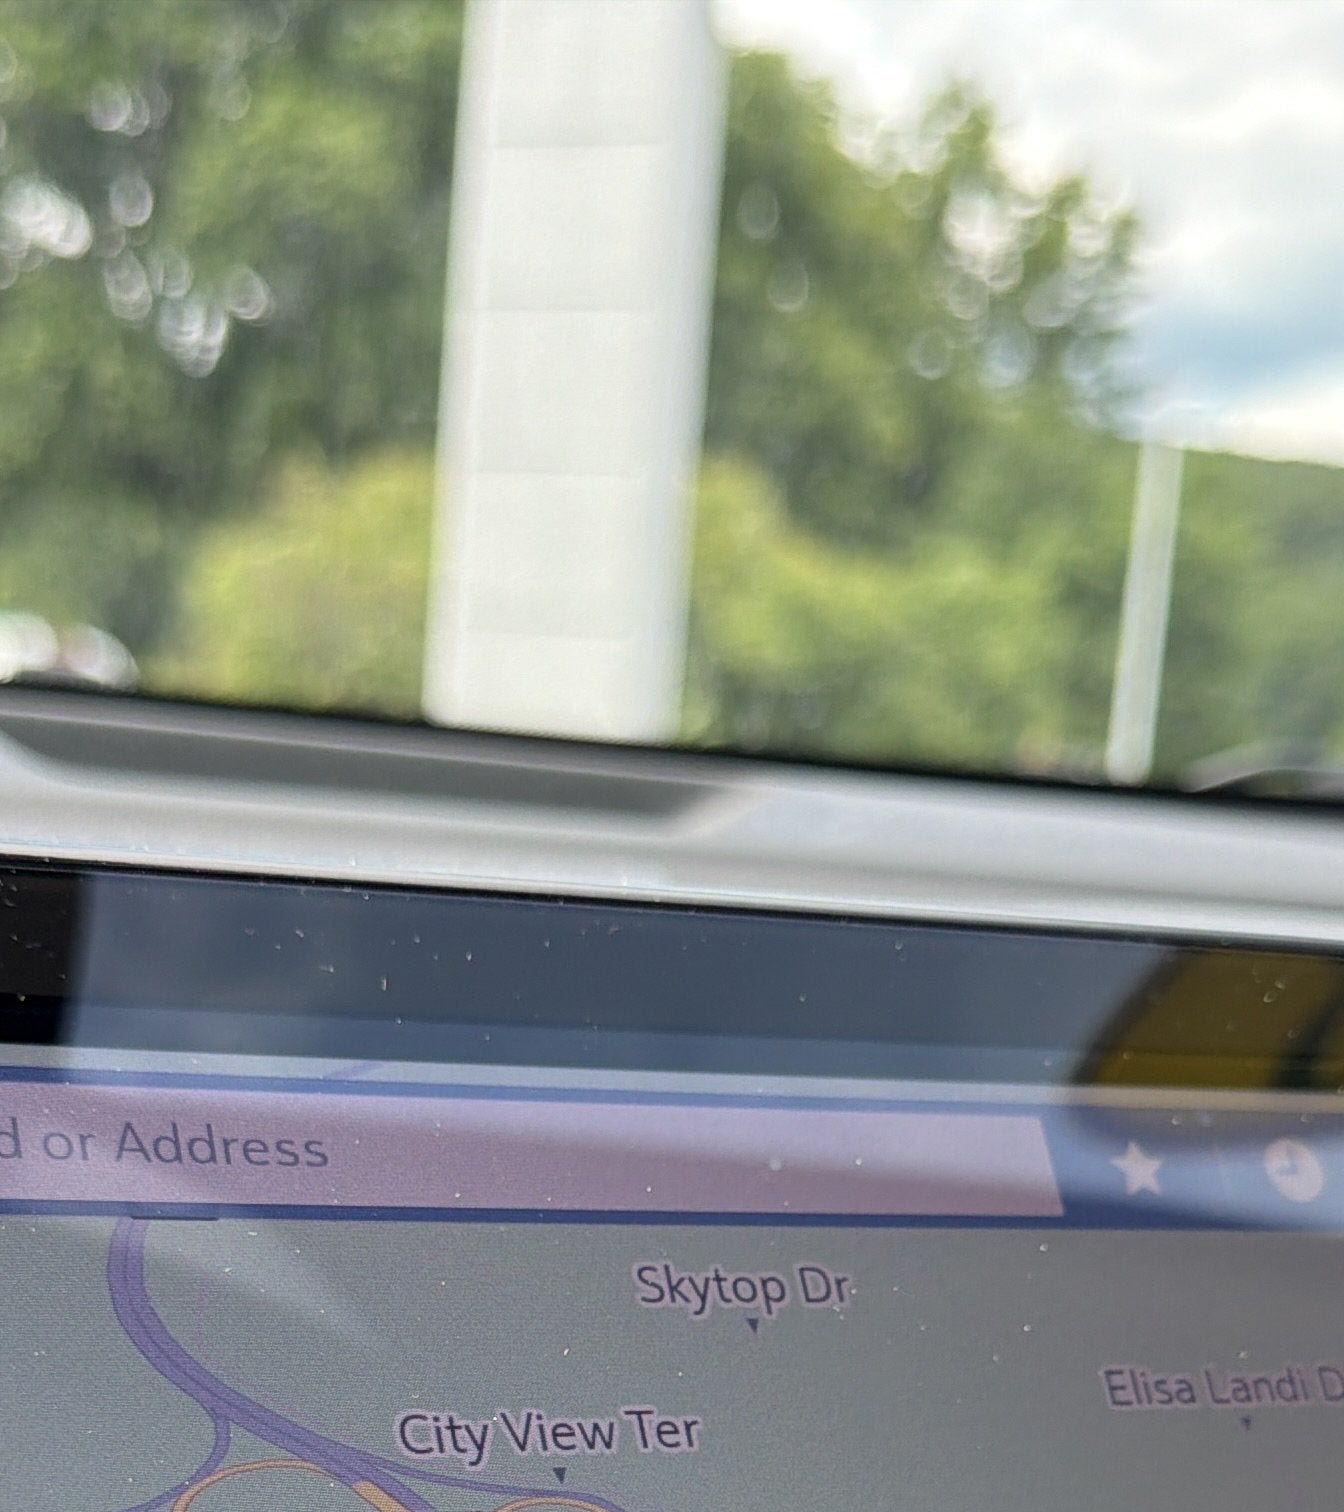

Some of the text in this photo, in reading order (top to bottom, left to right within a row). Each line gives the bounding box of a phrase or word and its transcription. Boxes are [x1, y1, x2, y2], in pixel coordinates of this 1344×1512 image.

[43, 1130, 94, 1161] or
[115, 1121, 329, 1168] Address
[636, 1265, 849, 1315] Skytop Dr
[1103, 1368, 1196, 1406] Elisa
[1205, 1368, 1310, 1404] Landi
[399, 1409, 700, 1466] City View Ter
